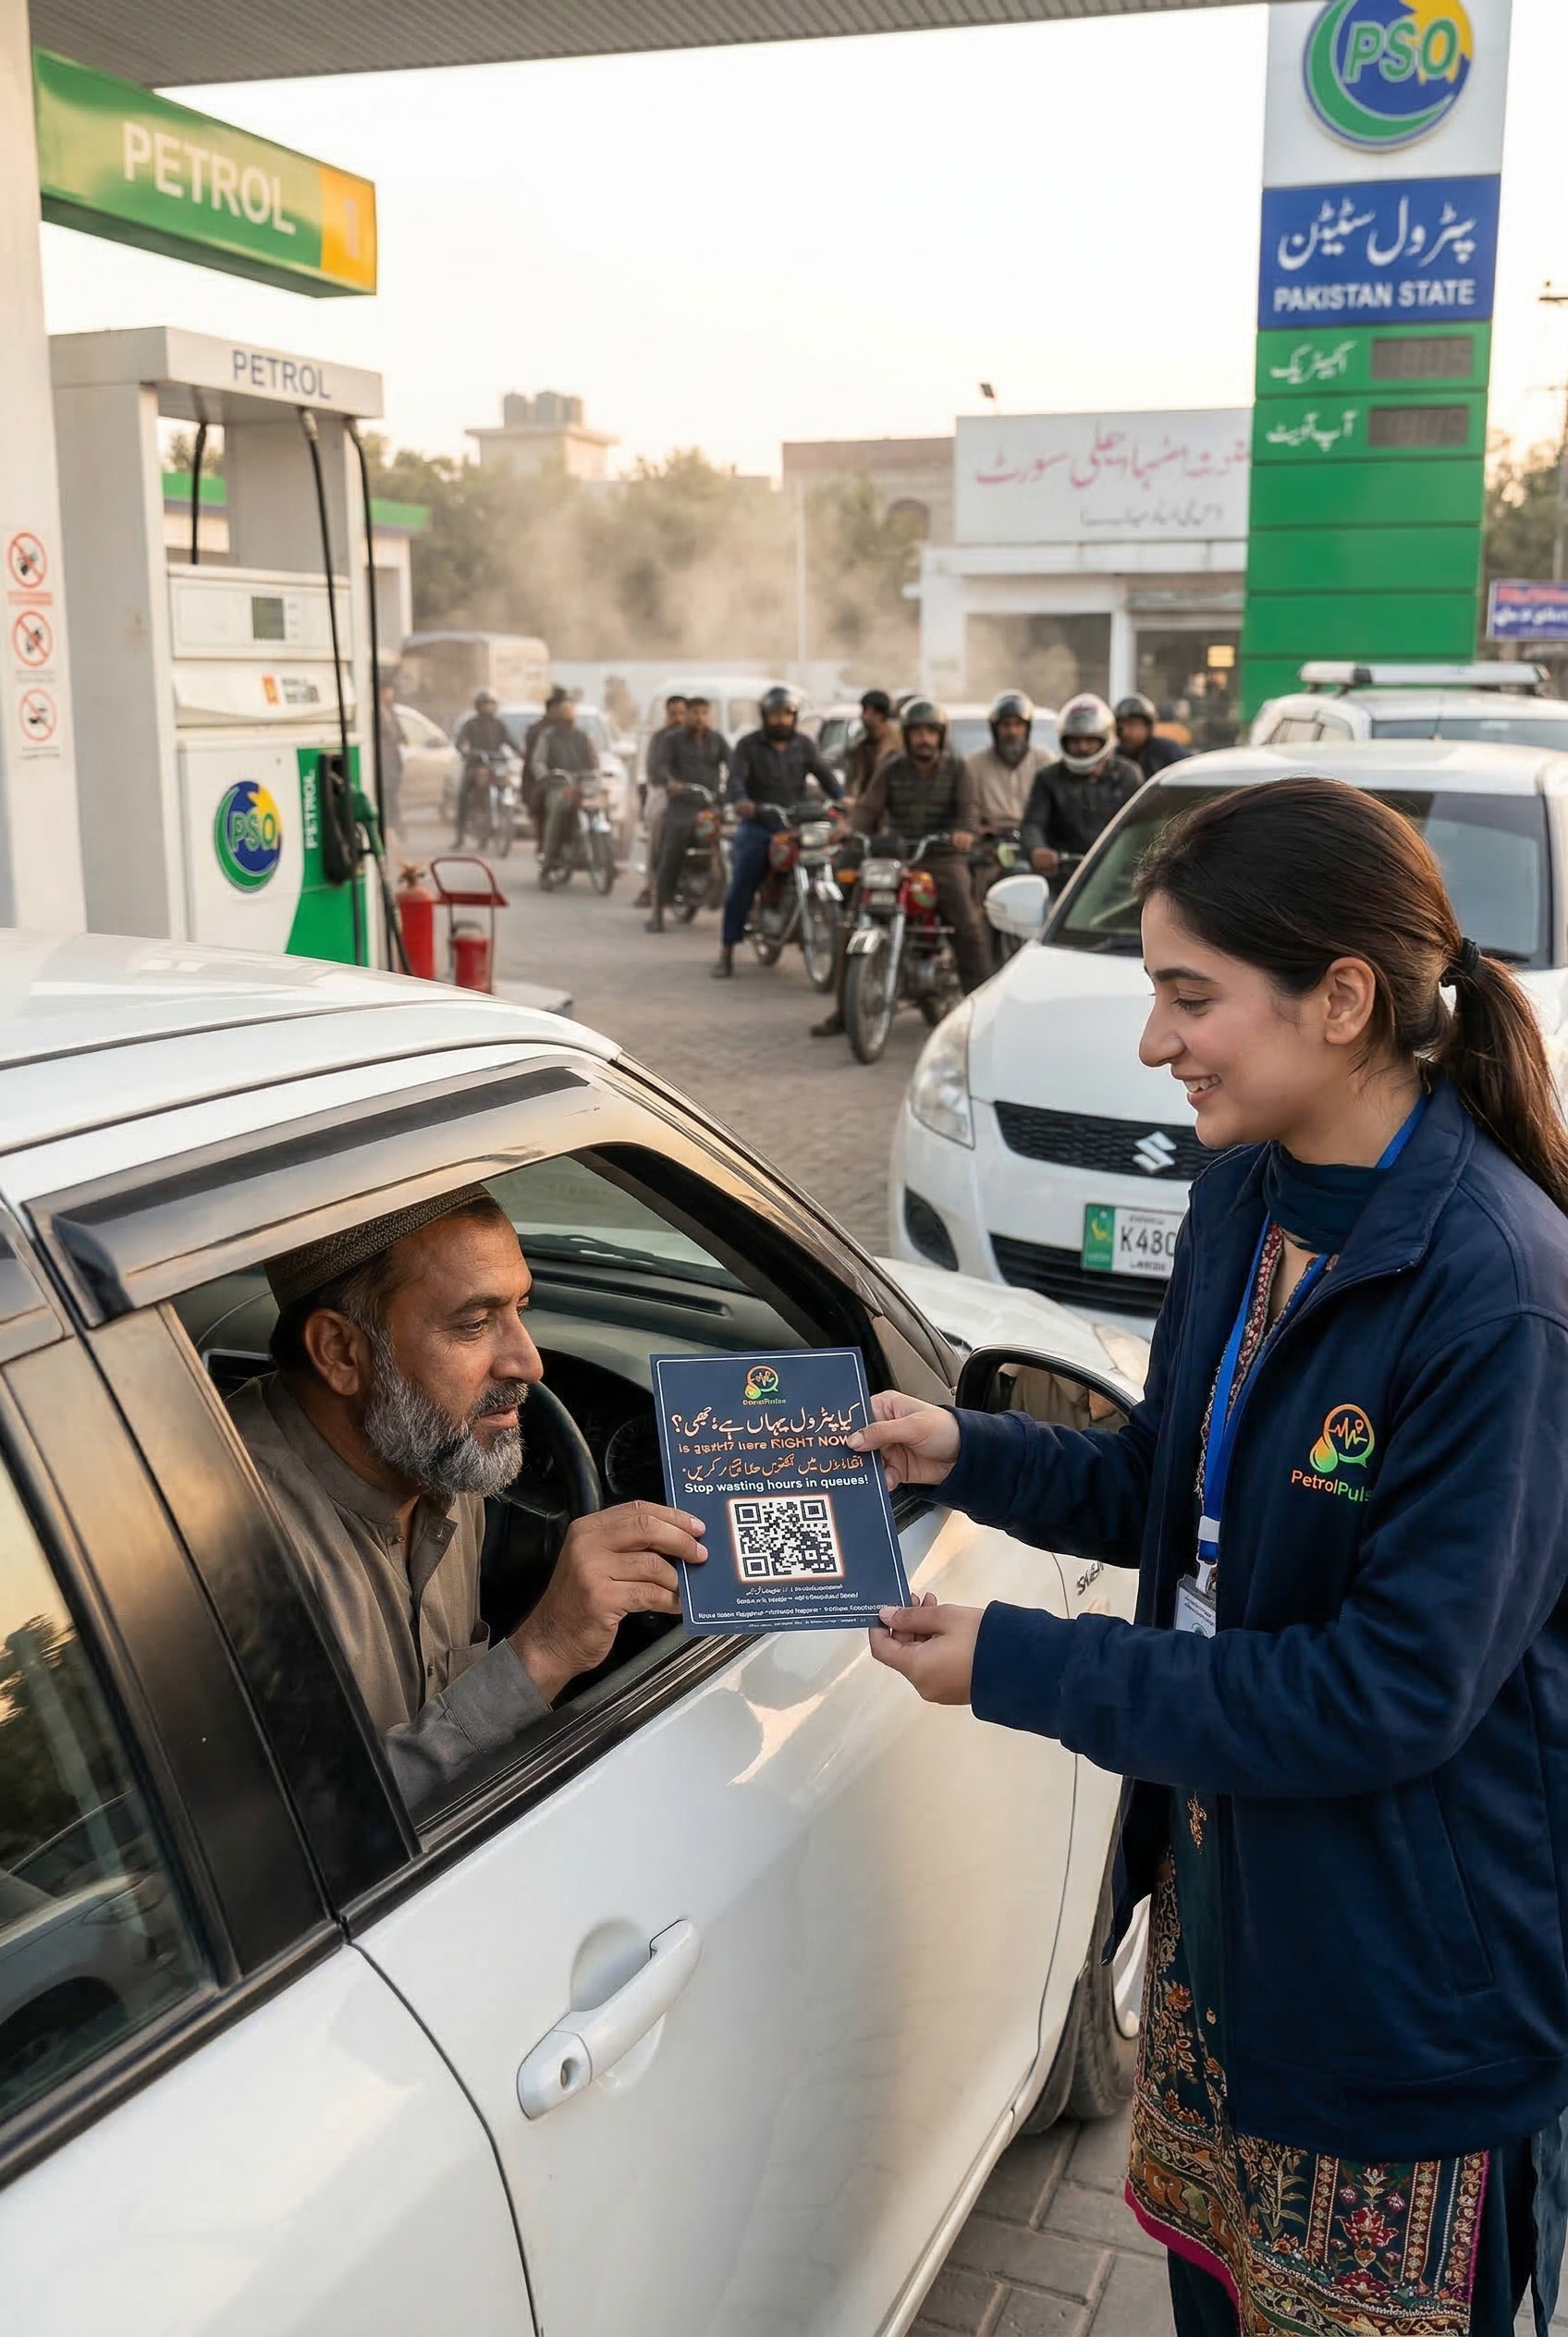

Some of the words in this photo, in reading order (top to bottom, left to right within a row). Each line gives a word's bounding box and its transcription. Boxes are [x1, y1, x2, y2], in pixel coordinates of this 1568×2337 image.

[1342, 18, 1460, 84] PSO
[122, 120, 297, 237] PETROL
[1366, 195, 1477, 268] پٹرول
[1273, 282, 1393, 312] PAKISTAN
[1398, 279, 1476, 307] STATE
[232, 349, 332, 400] PETROL
[230, 810, 277, 853] PSO
[302, 768, 318, 849] PETROL
[770, 1437, 814, 1450] RIGHT
[684, 1483, 714, 1495] Stop
[717, 1480, 764, 1492] wasting
[766, 1479, 803, 1490] hours
[805, 1477, 818, 1487] in
[820, 1474, 869, 1488] queues!
[1291, 1469, 1374, 1502] PetrolPuls
